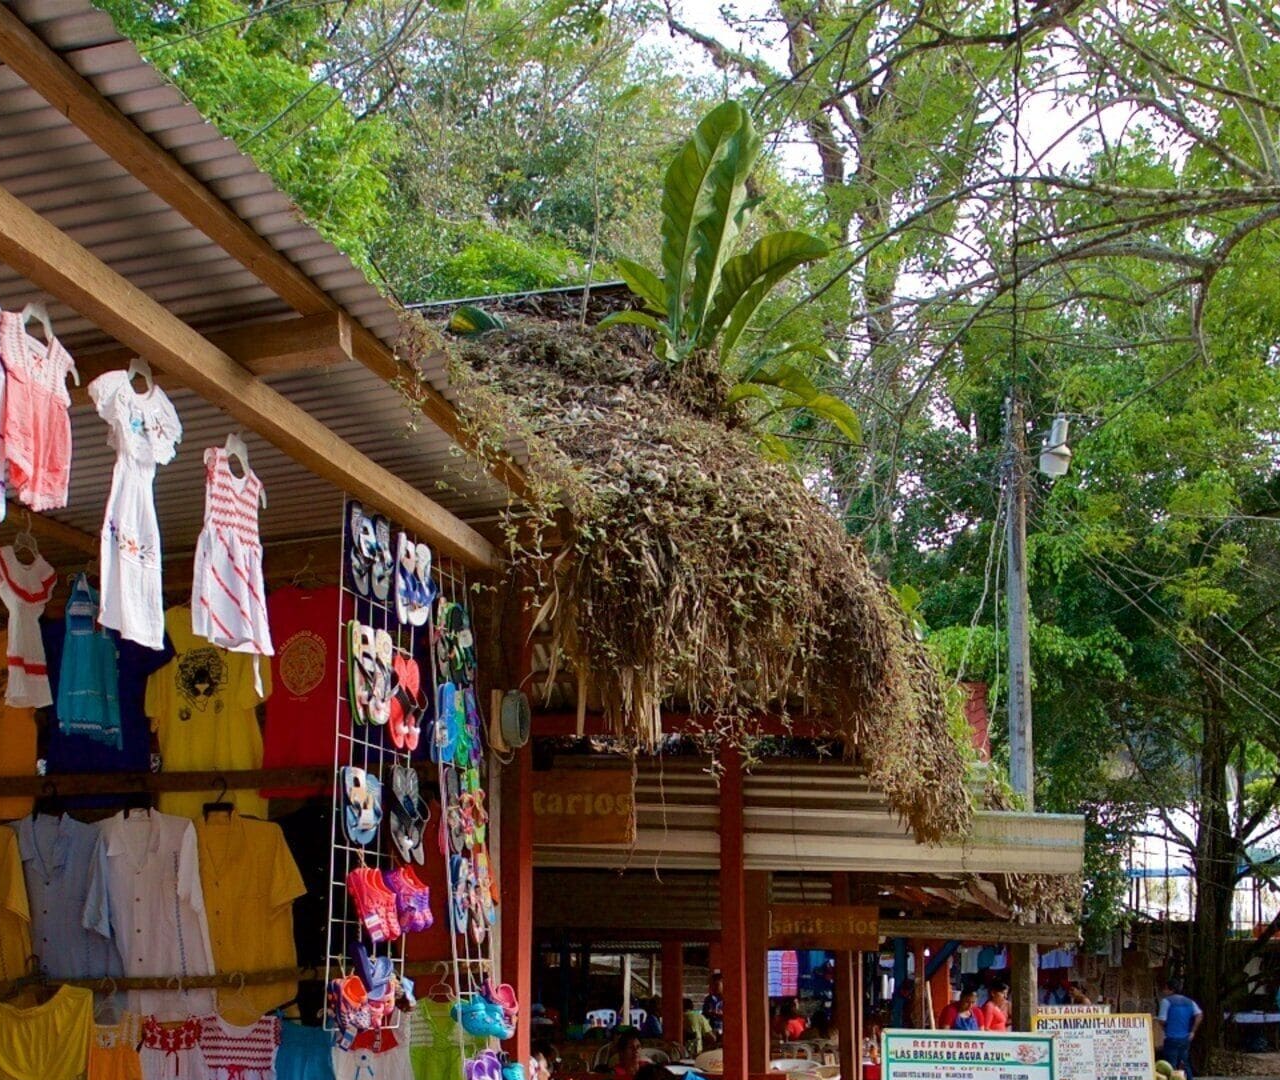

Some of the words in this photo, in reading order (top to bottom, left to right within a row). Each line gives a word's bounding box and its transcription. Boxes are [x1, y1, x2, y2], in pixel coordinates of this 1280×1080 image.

[913, 1040, 985, 1049] RESTAURANT
[913, 1050, 944, 1060] BRISAS
[946, 1052, 957, 1060] DE
[959, 1052, 982, 1061] AGUA
